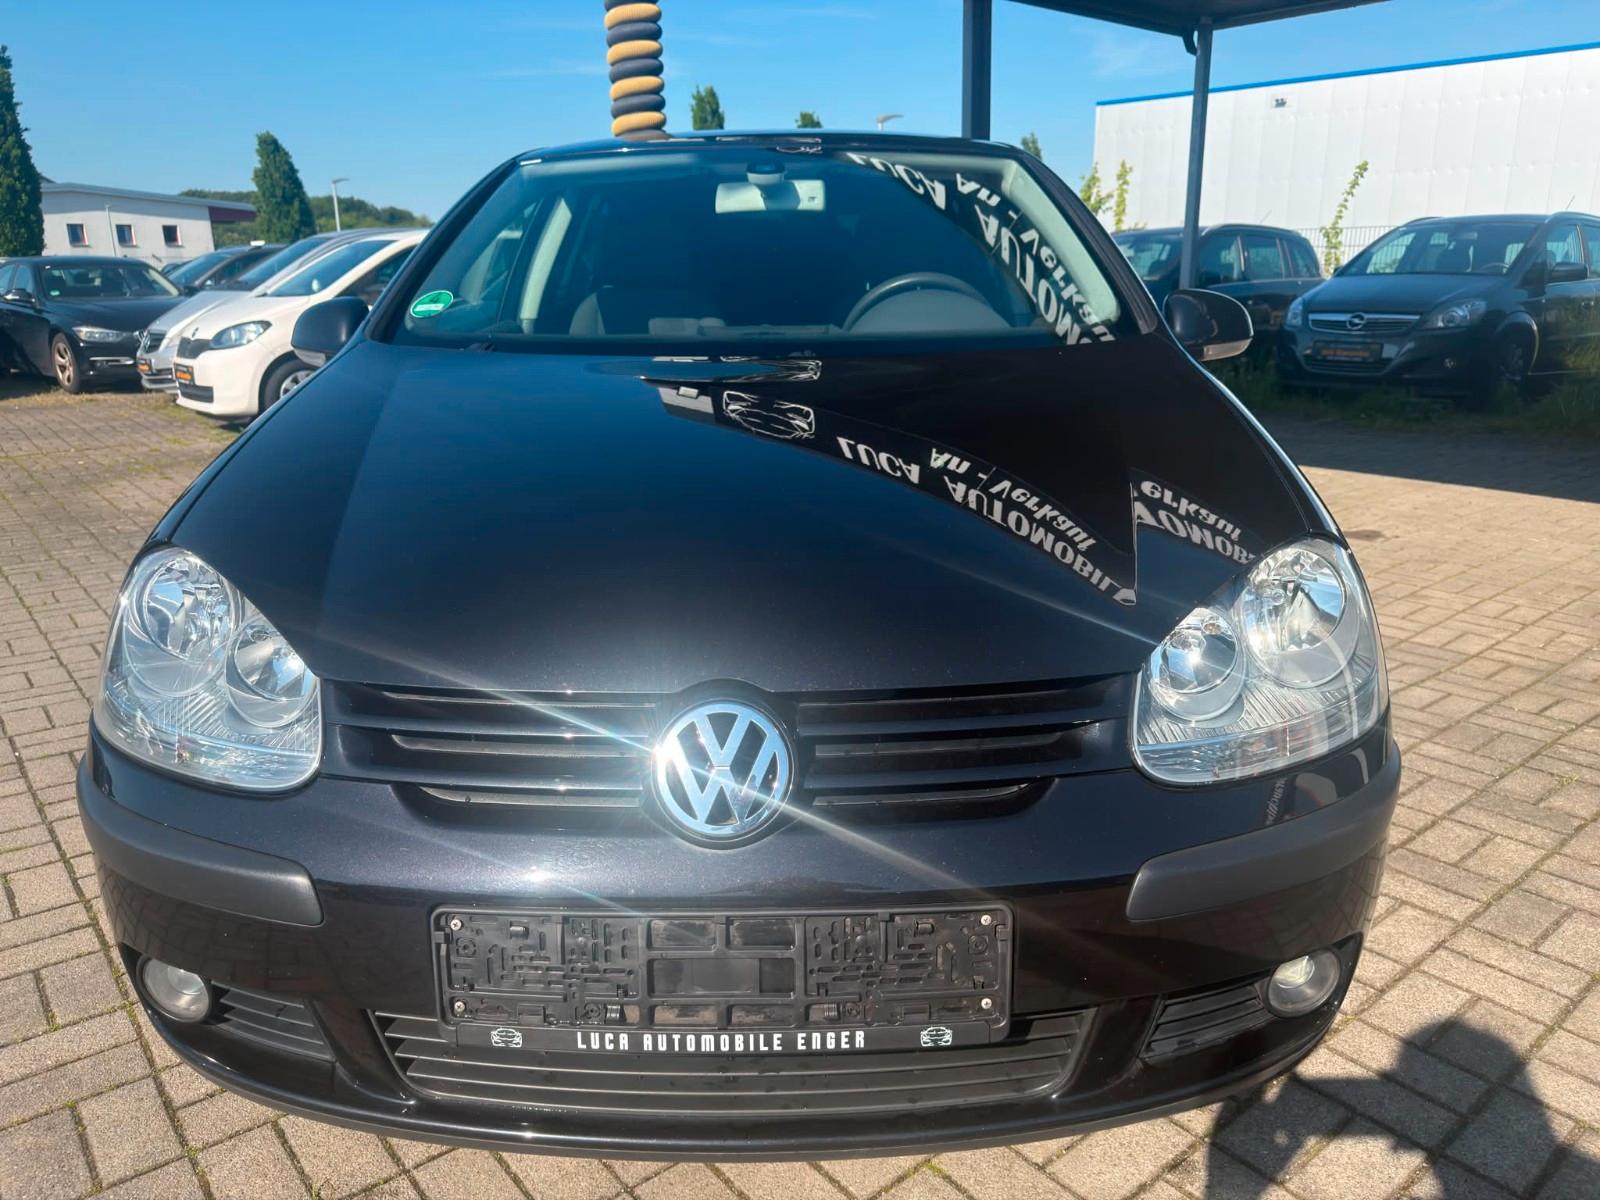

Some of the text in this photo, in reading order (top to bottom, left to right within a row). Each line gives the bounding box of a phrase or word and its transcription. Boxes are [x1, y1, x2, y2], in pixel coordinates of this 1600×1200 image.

[576, 1030, 866, 1052] LUCA AUTOMOBILE ENGER
